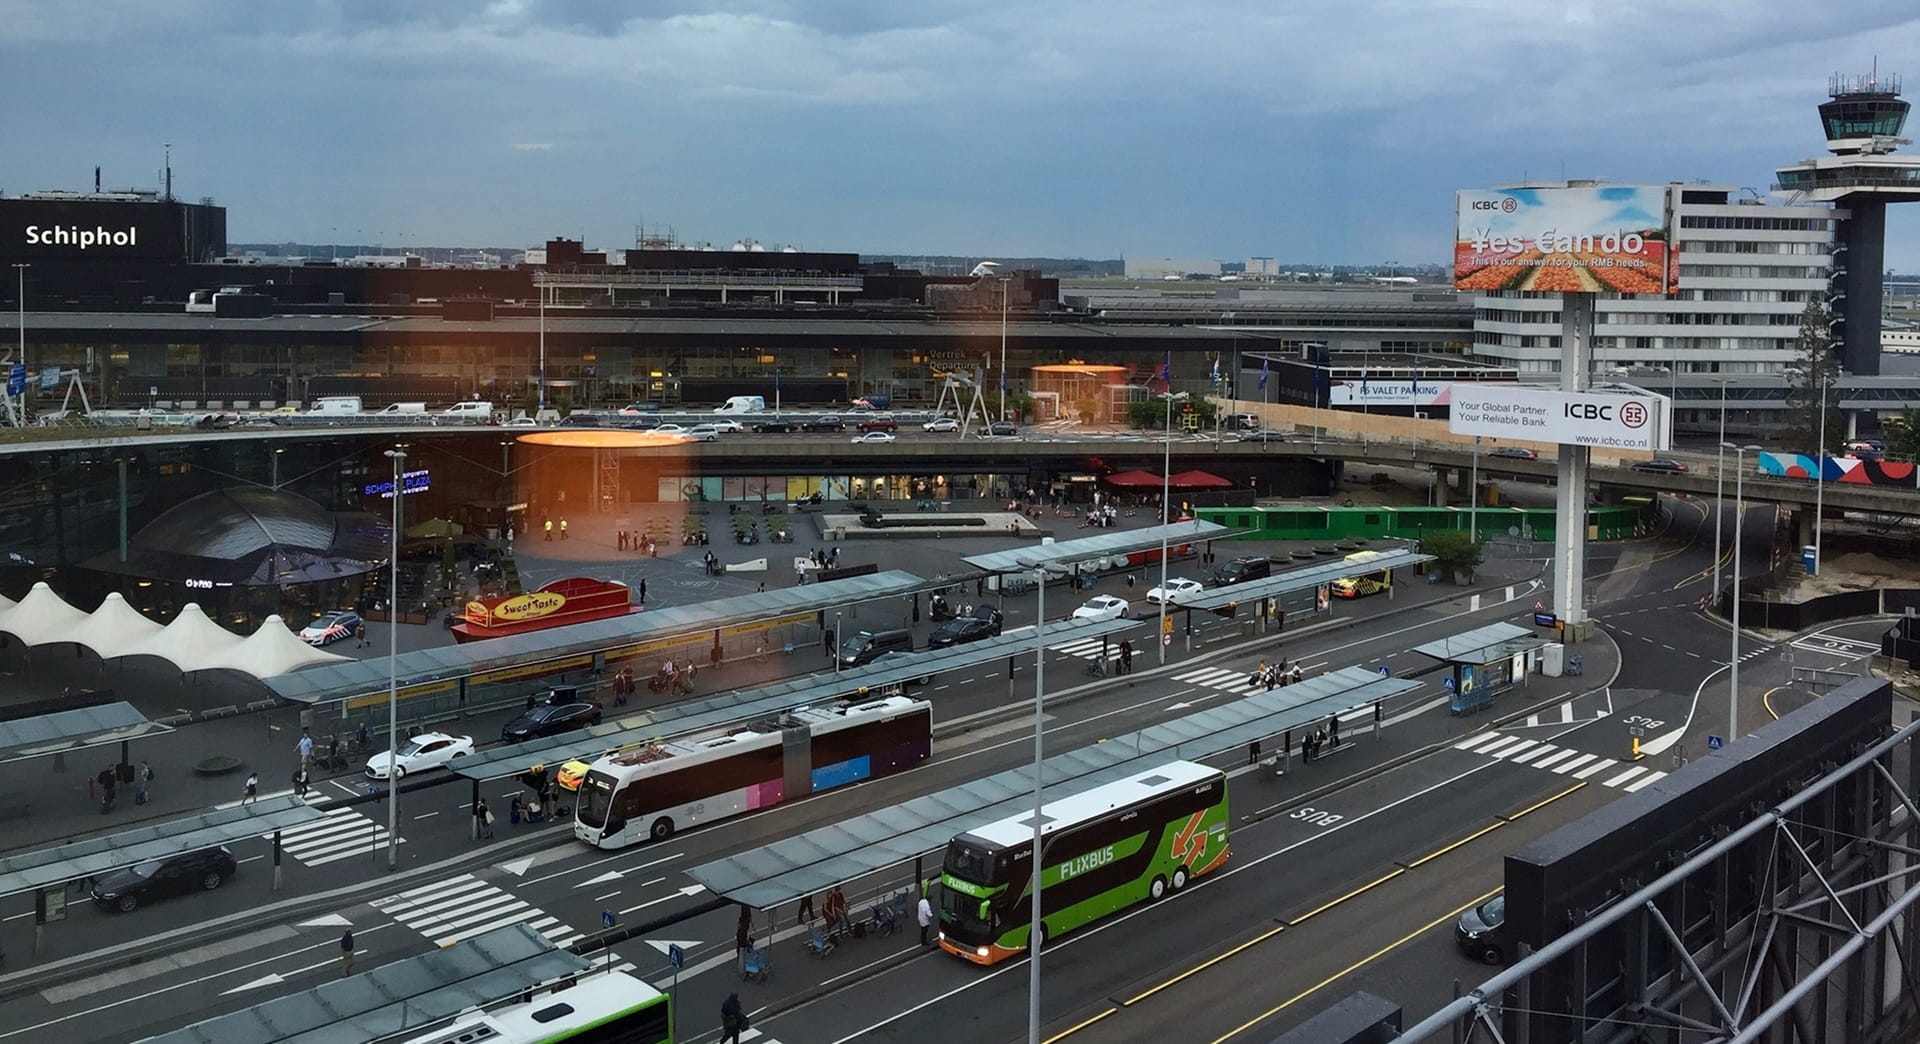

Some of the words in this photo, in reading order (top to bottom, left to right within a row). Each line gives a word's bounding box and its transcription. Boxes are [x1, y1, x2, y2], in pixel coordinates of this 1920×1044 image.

[1472, 201, 1498, 210] ICBC
[26, 225, 136, 249] Schiphol
[1601, 229, 1648, 255] do.
[1471, 257, 1488, 266] This
[1491, 258, 1498, 266] is
[1553, 258, 1566, 267] for
[1568, 260, 1589, 269] your
[1591, 258, 1613, 267] RMB
[1616, 259, 1648, 268] needs.
[930, 350, 966, 359] Vertrek
[982, 351, 991, 369] 1
[1373, 386, 1399, 395] VALET
[1401, 386, 1438, 395] PAKING
[1459, 401, 1480, 411] Your
[1482, 403, 1510, 413] Global
[1513, 405, 1549, 416] Partner.
[1565, 403, 1612, 420] ICBC
[1459, 413, 1480, 422] Your
[1483, 415, 1519, 425] Reliable
[1522, 418, 1548, 427] Bank.
[1576, 434, 1647, 448] www.icbc.co.nl
[406, 476, 430, 487] PLAZA
[504, 603, 531, 615] Sweet
[532, 598, 558, 609] Taste
[1623, 715, 1665, 729] BUS
[1290, 807, 1344, 826] BUS
